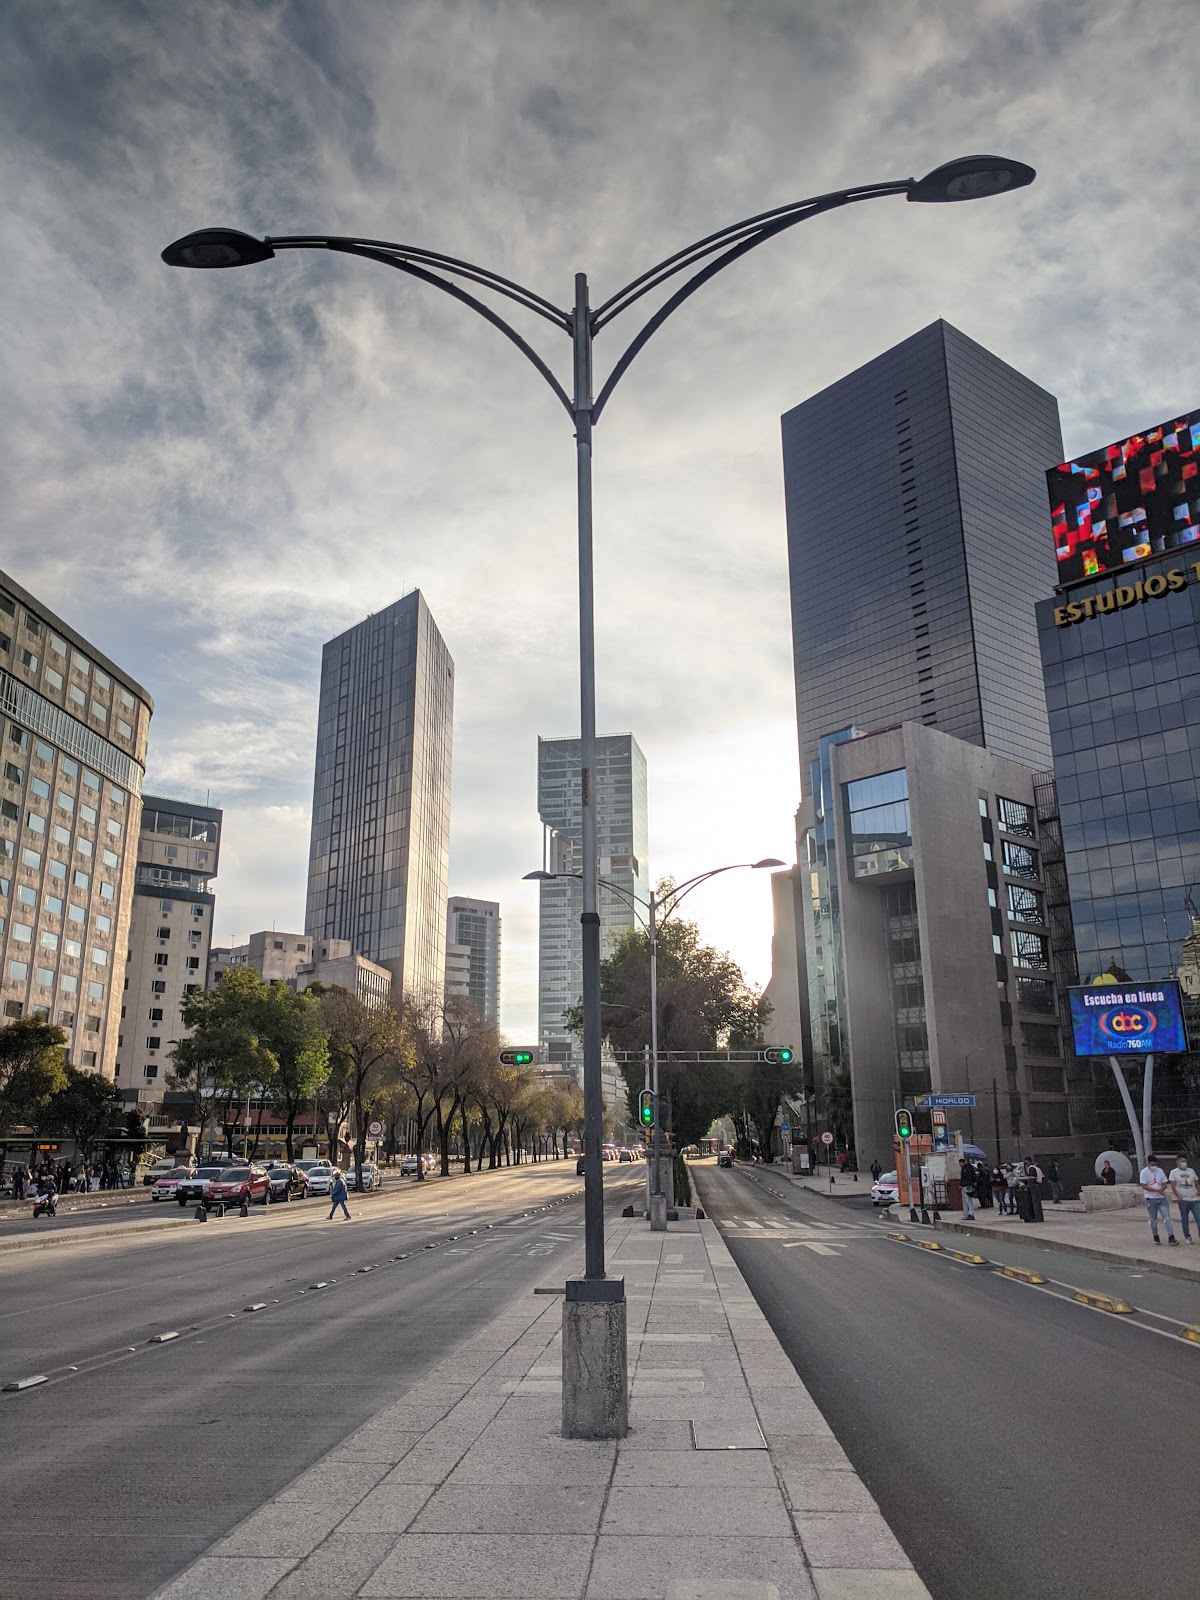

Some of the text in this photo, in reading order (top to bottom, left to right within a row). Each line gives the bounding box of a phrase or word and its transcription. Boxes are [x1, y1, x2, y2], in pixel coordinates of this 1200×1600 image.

[1053, 569, 1185, 626] ESTUDIOS
[1084, 990, 1164, 1006] Escucha en línea
[1112, 1012, 1143, 1031] abc
[935, 1097, 970, 1105] HIDALGO
